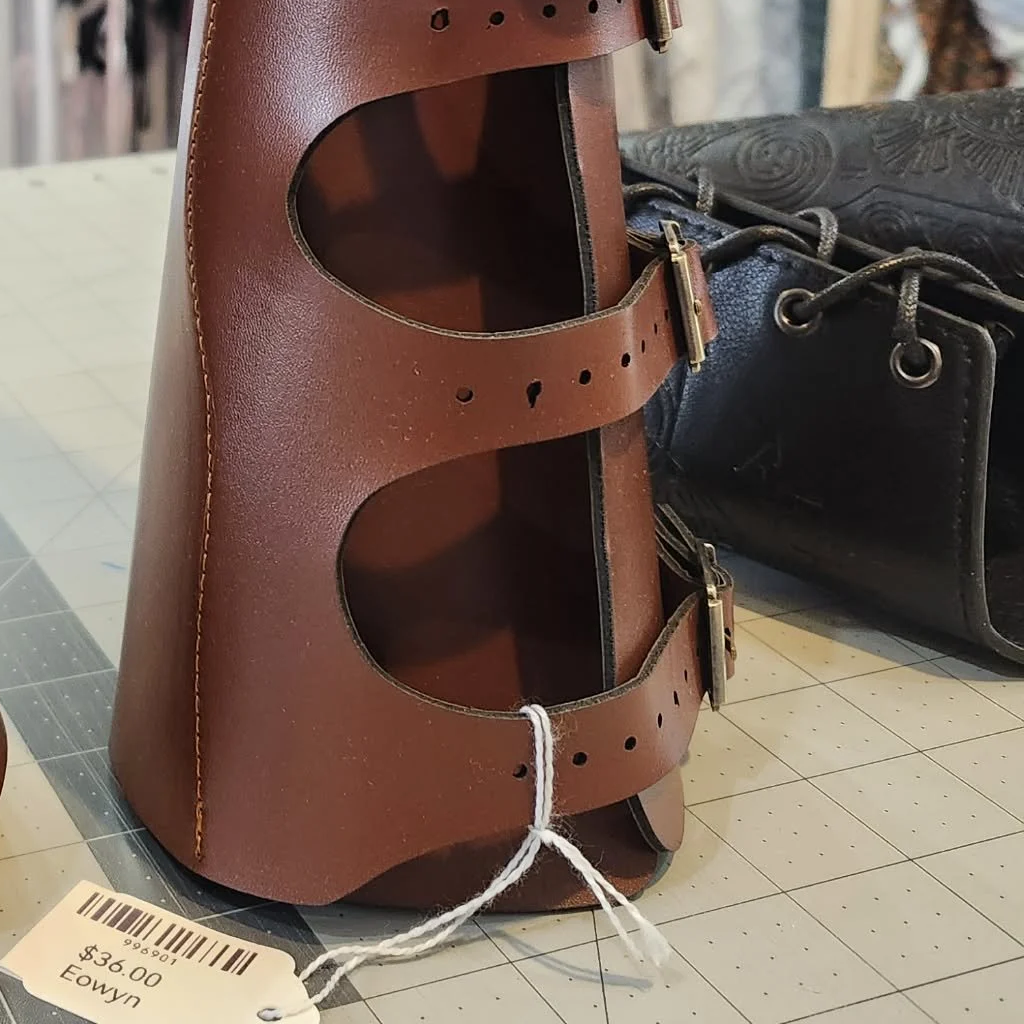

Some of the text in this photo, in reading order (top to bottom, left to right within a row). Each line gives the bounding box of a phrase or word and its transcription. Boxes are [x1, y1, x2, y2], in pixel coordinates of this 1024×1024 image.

[78, 944, 163, 989] $36.00
[123, 938, 178, 966] 996901
[59, 964, 141, 1009] Eowyn
